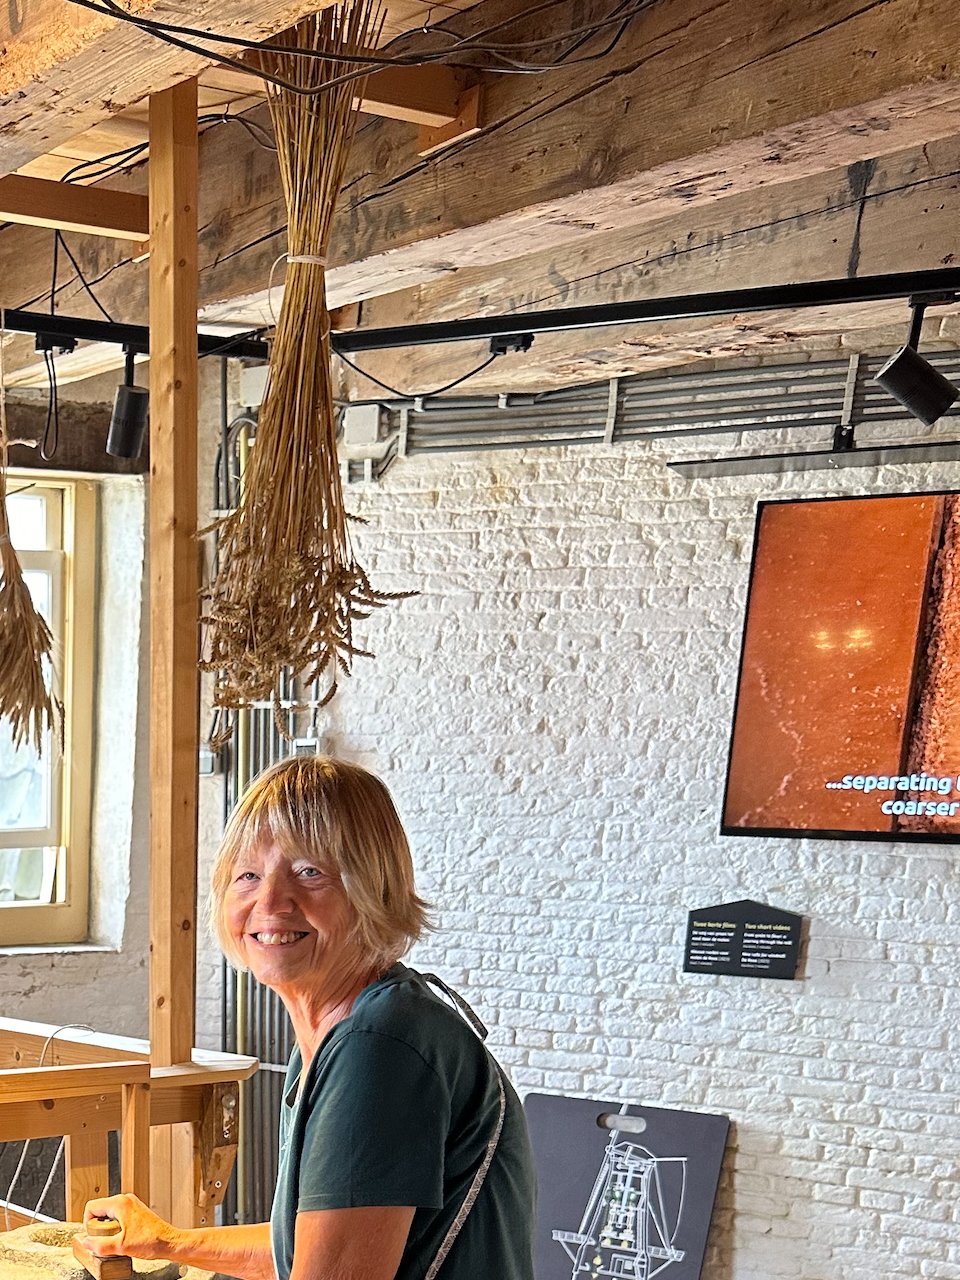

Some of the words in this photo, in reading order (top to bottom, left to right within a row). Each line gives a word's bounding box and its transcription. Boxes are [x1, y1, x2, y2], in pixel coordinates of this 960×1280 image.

[825, 772, 952, 795] ...separating
[881, 800, 960, 816] coarser
[757, 923, 772, 931] short
[772, 923, 791, 931] videos
